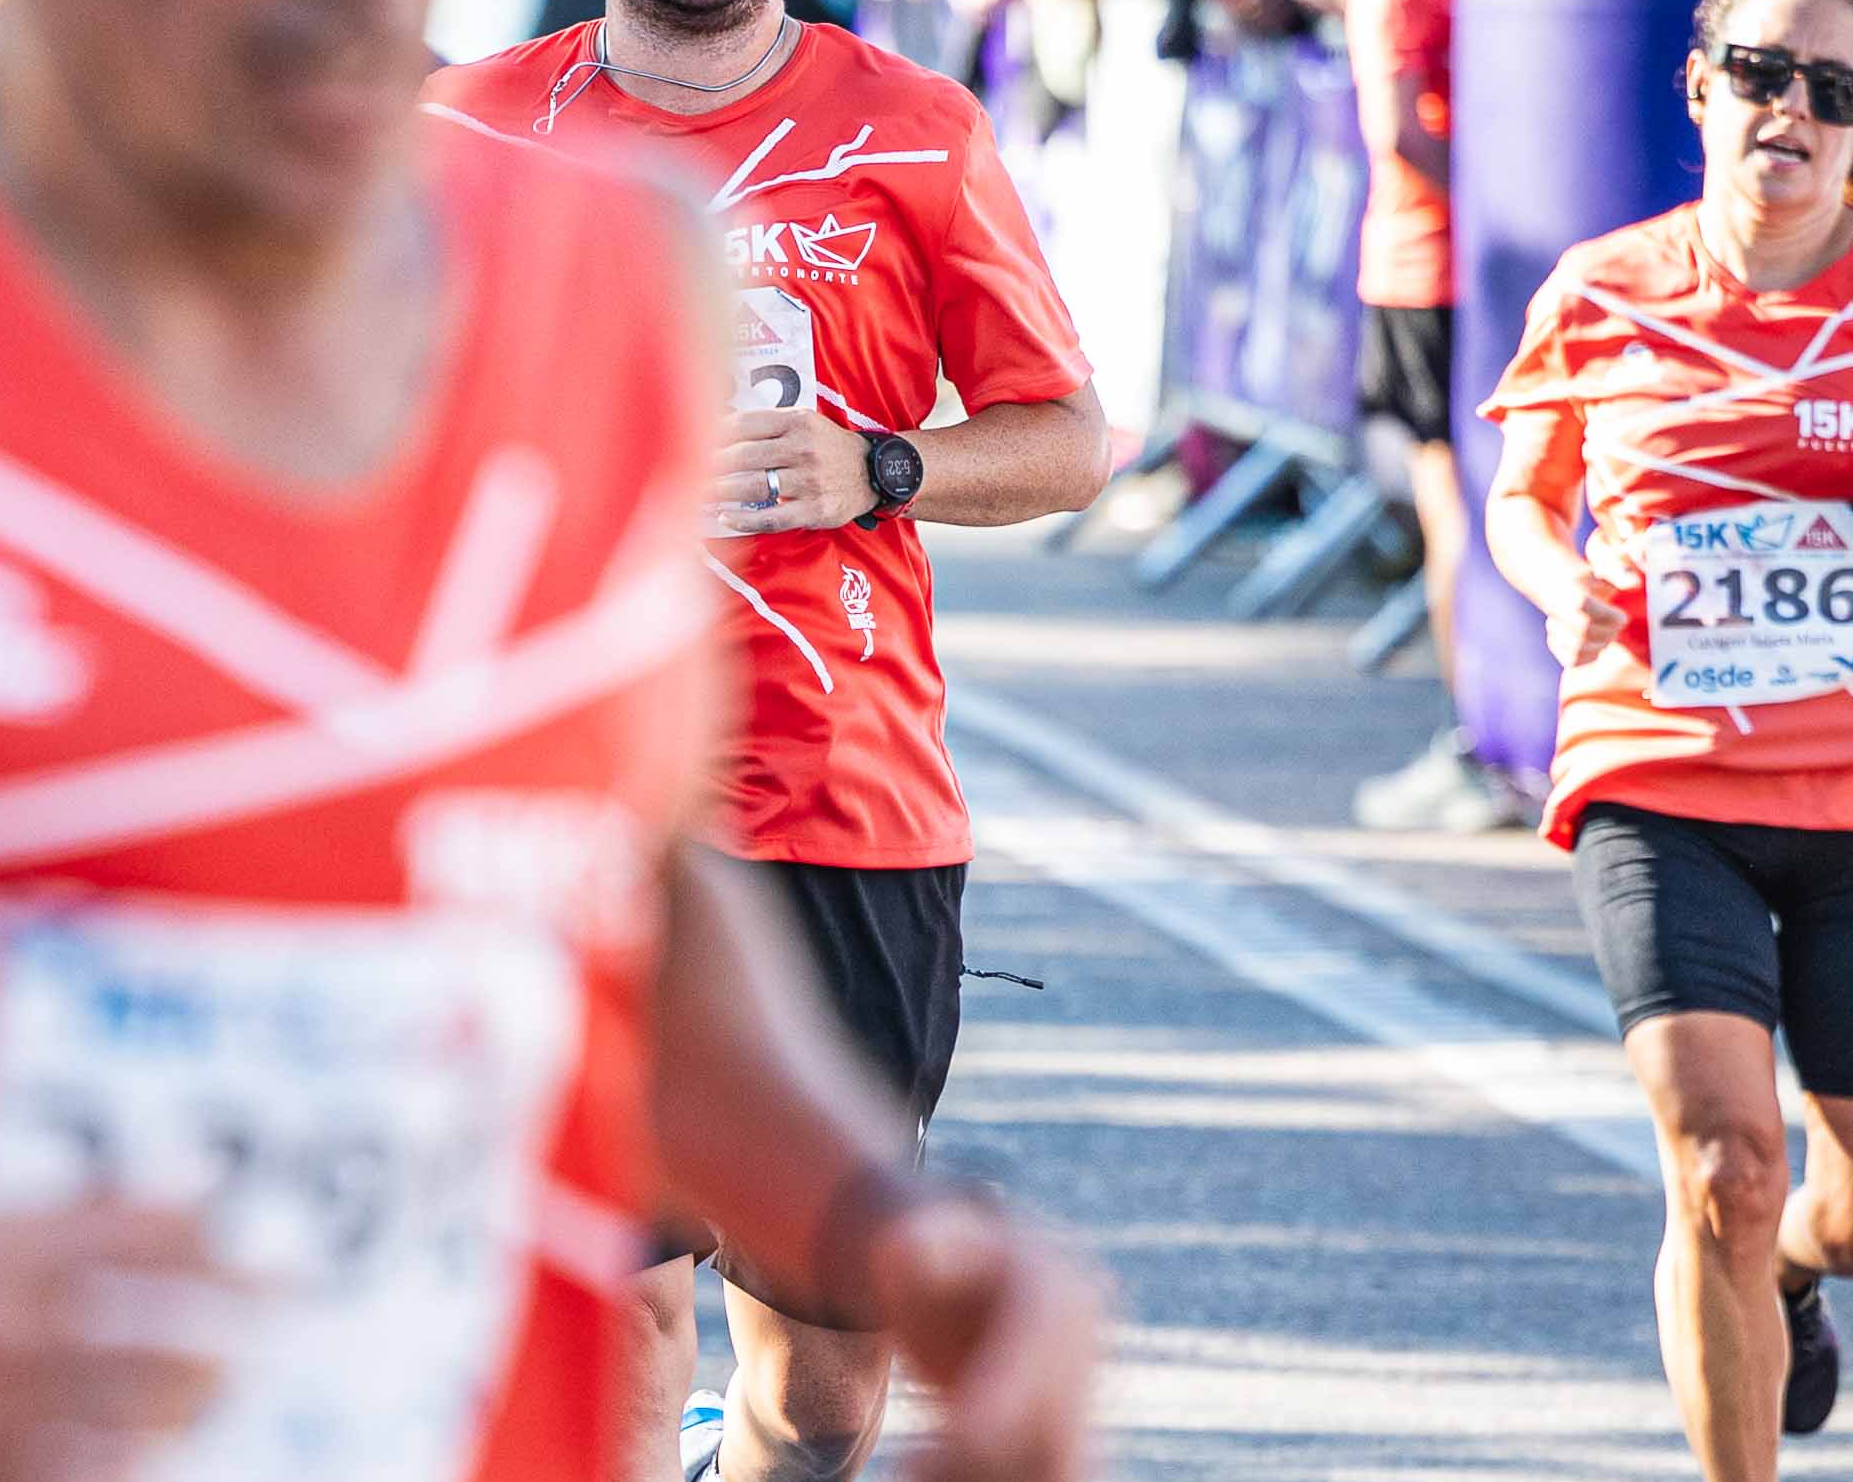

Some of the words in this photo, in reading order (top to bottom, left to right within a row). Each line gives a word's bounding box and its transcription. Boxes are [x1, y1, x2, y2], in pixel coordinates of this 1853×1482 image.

[796, 268, 860, 286] NORTE
[1674, 522, 1729, 549] 15K
[1659, 568, 1853, 628] 2186
